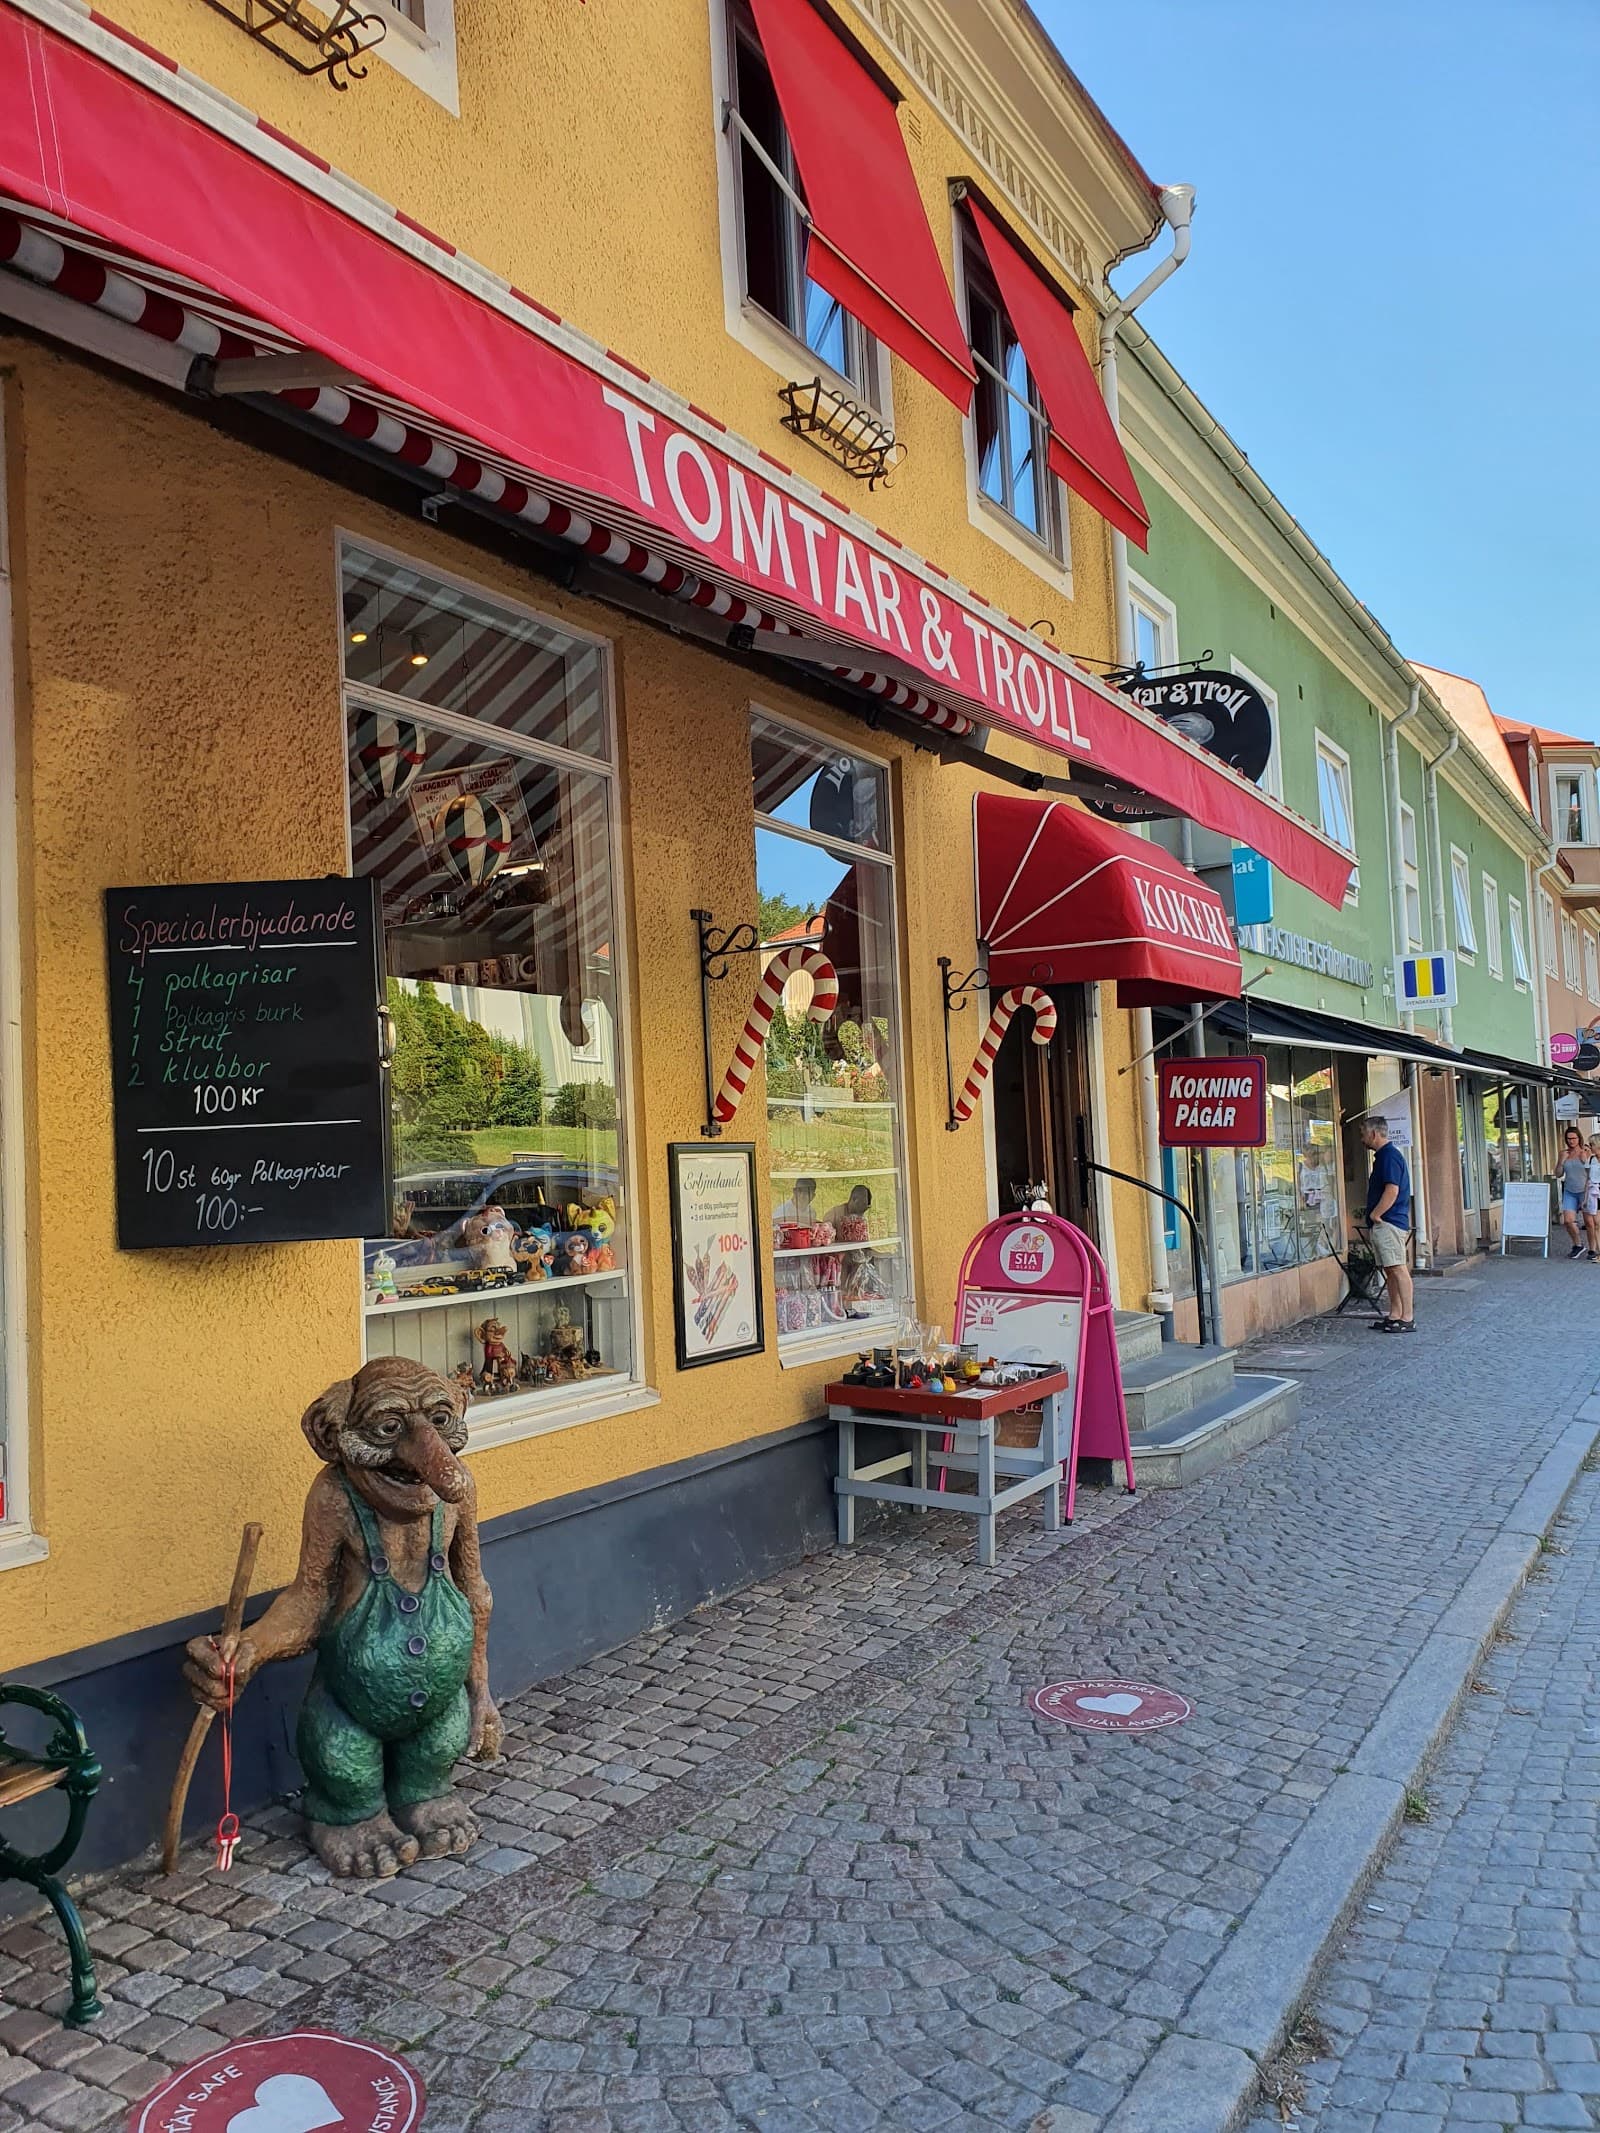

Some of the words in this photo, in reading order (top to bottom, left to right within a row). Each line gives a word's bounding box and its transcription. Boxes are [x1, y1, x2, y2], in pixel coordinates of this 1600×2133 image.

[600, 383, 913, 654] TOMTAR
[919, 587, 962, 681] &
[962, 613, 1092, 750] TROLL
[1132, 875, 1235, 951] KOKERI
[120, 900, 356, 967] Specialerbjudande
[128, 964, 144, 1000] 4
[165, 963, 297, 1010] polkagrisar
[132, 1007, 140, 1028] 1
[166, 1003, 246, 1030] Polkagris
[256, 1003, 304, 1023] burk
[131, 1036, 140, 1056] 1
[128, 1063, 144, 1086] 2
[1169, 1075, 1253, 1098] KOKNING
[194, 1085, 236, 1114] 100
[1175, 1100, 1237, 1127] PÅGÅR
[142, 1148, 175, 1192] 10
[177, 1164, 197, 1189] st
[251, 1159, 350, 1190] Polkagrisar
[683, 1170, 743, 1197] Erbjudande
[196, 1193, 264, 1231] 100:-
[718, 1233, 748, 1253] 100:-
[1014, 1252, 1038, 1265] SIA
[187, 2064, 243, 2102] SAFE
